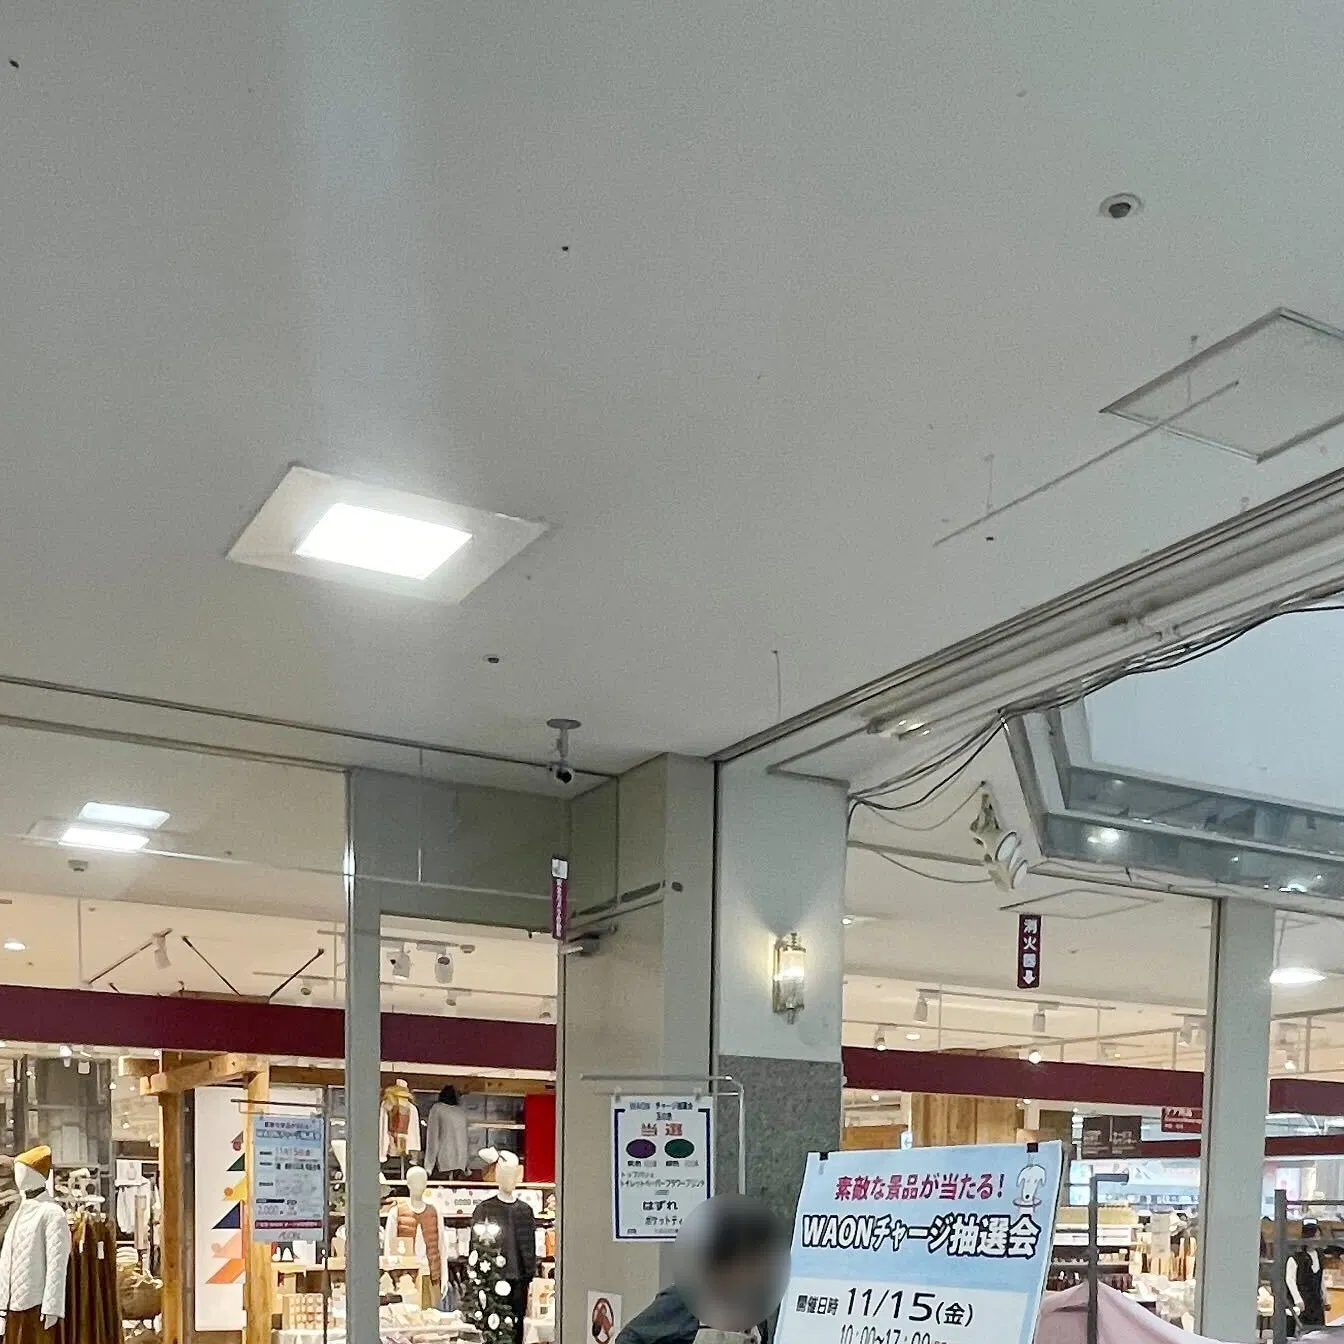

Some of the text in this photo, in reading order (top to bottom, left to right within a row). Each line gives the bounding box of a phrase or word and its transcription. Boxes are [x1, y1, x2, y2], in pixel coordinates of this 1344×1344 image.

[835, 1173, 1005, 1200] 素敵な景品が当たる!
[642, 1200, 679, 1211] はずれ
[802, 1211, 1042, 1259] WAONチャージ抽選会
[796, 1287, 974, 1327] 開催日時 11/15(金)
